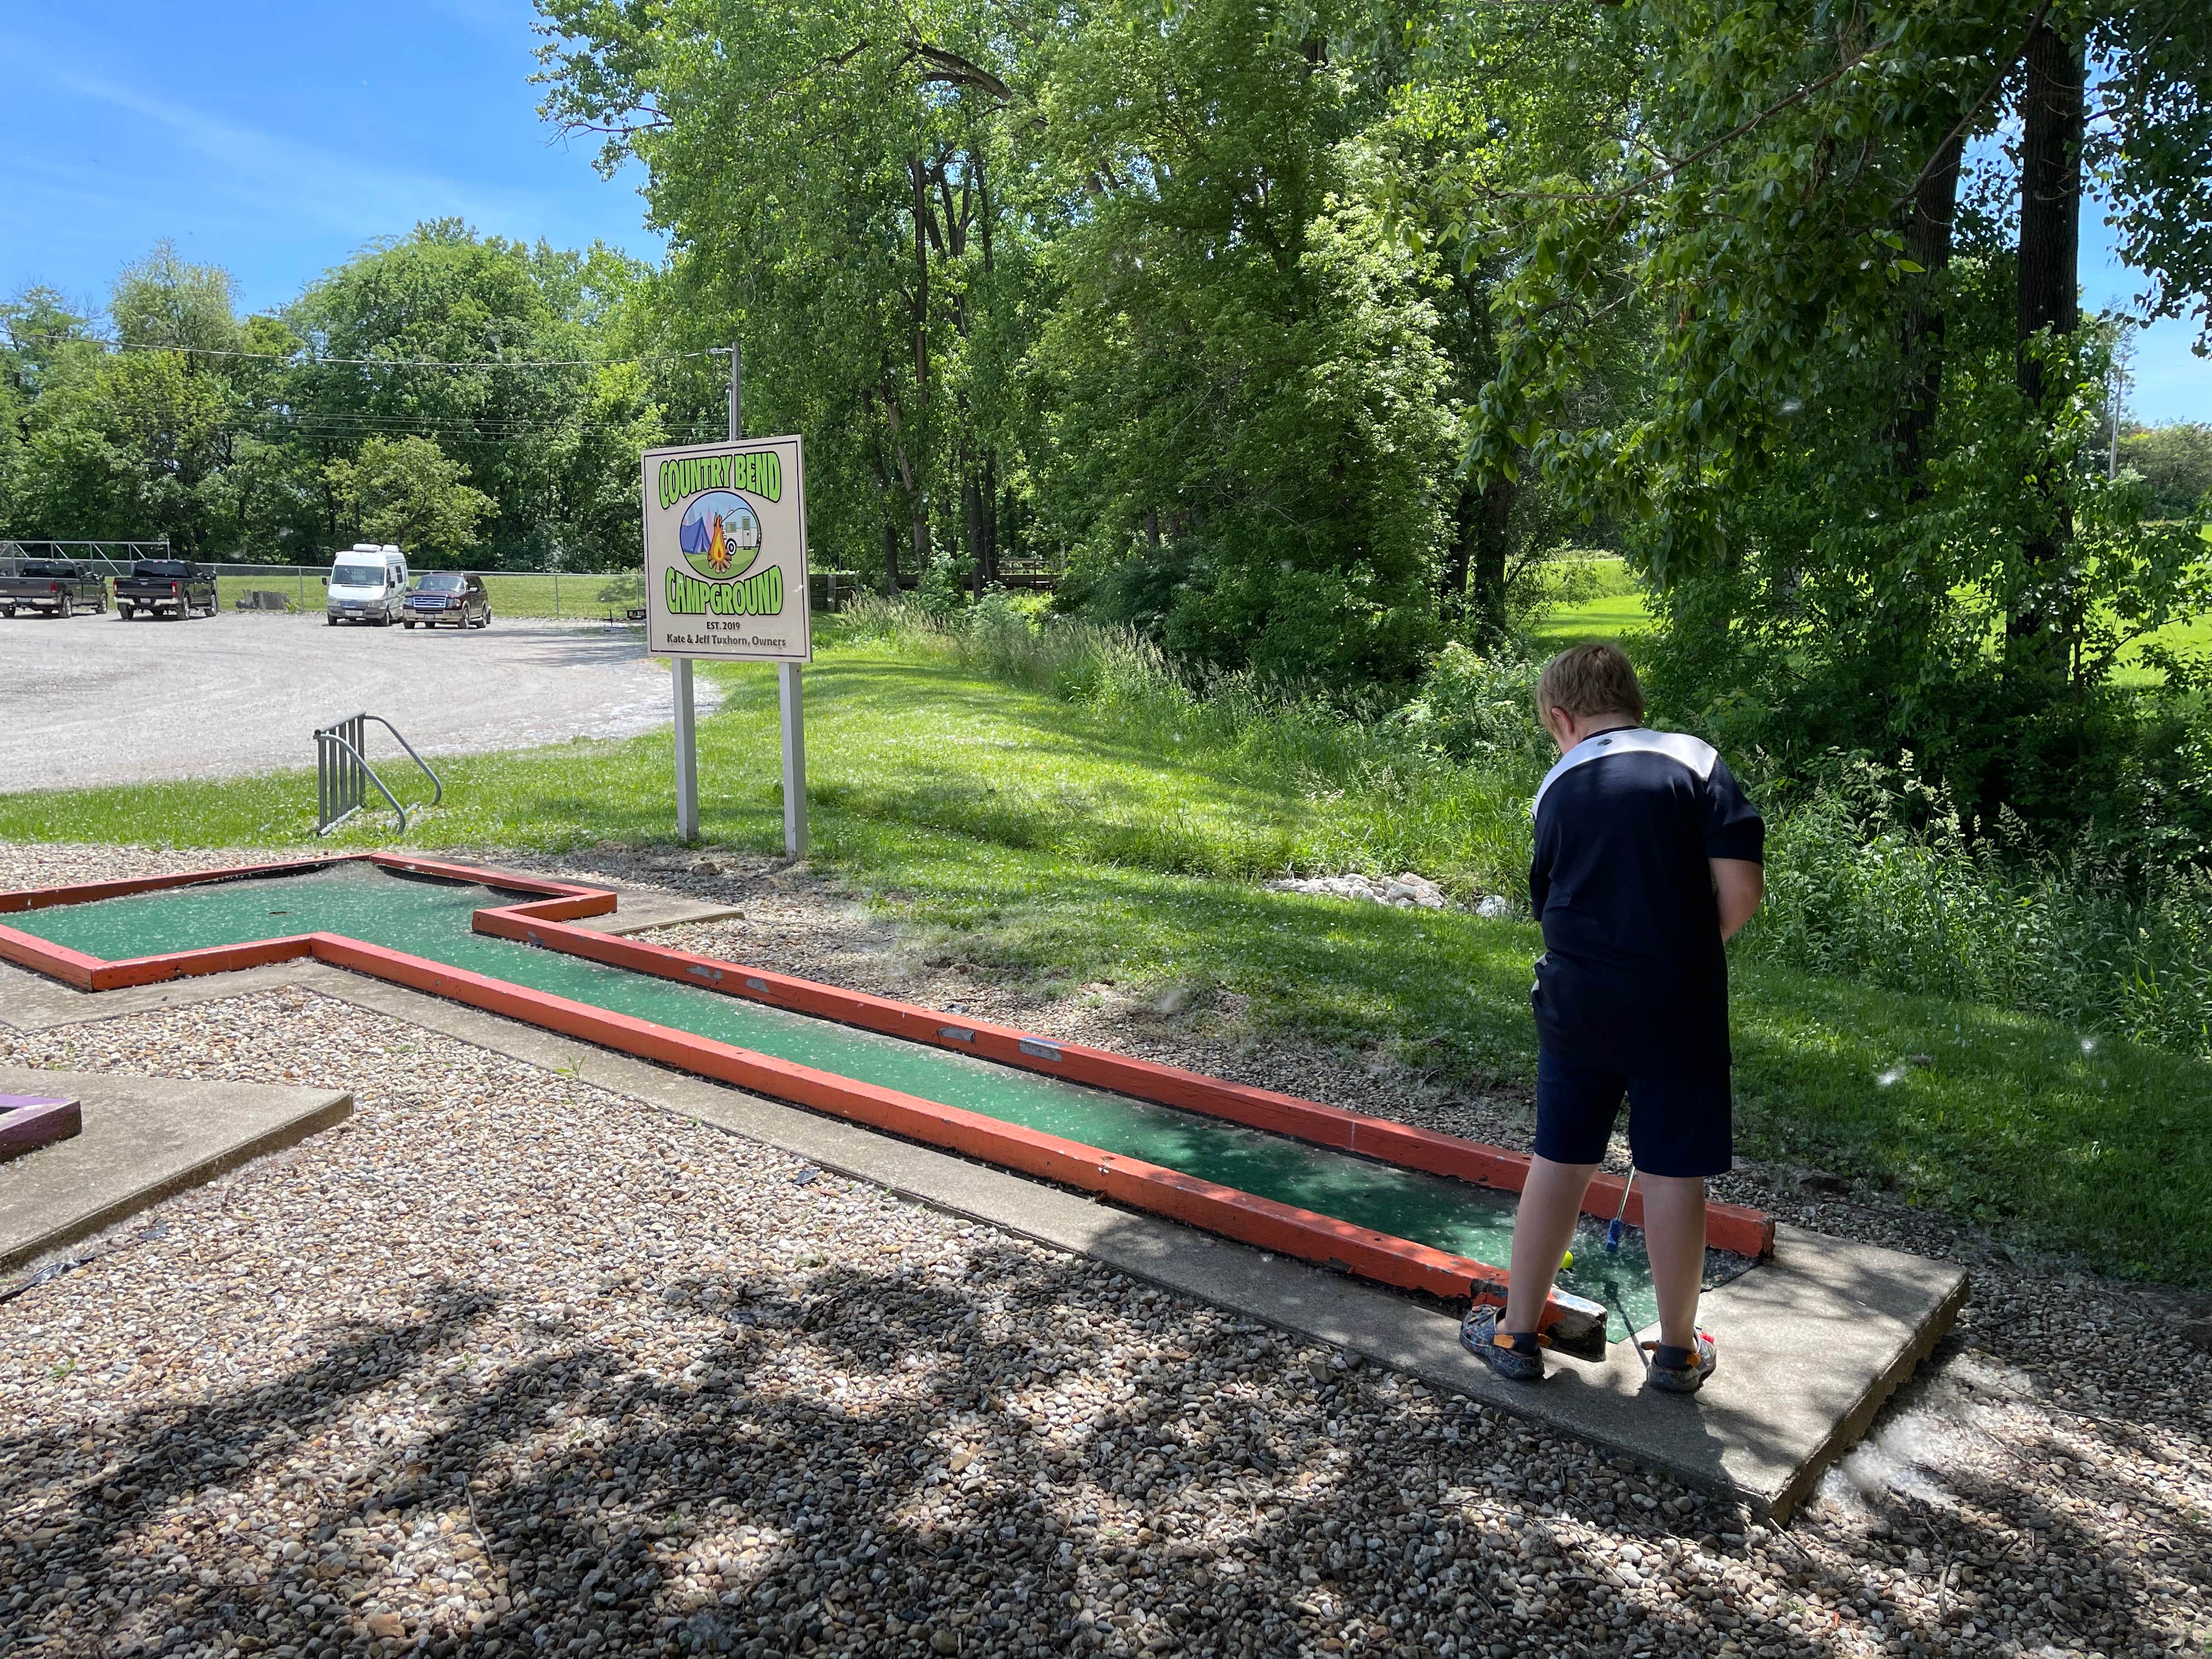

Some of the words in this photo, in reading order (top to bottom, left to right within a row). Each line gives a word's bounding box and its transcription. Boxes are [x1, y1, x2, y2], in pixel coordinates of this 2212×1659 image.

[659, 455, 732, 510] COUNTRY
[734, 451, 781, 503] BEND
[665, 565, 783, 616] CAMPGROUND
[667, 634, 685, 643] Kate
[687, 634, 693, 644] &
[695, 635, 710, 644] Jeff
[712, 635, 750, 646] Tuxhorn,
[752, 636, 786, 646] Owners
[707, 622, 721, 630] EST.
[723, 622, 740, 630] 2019
